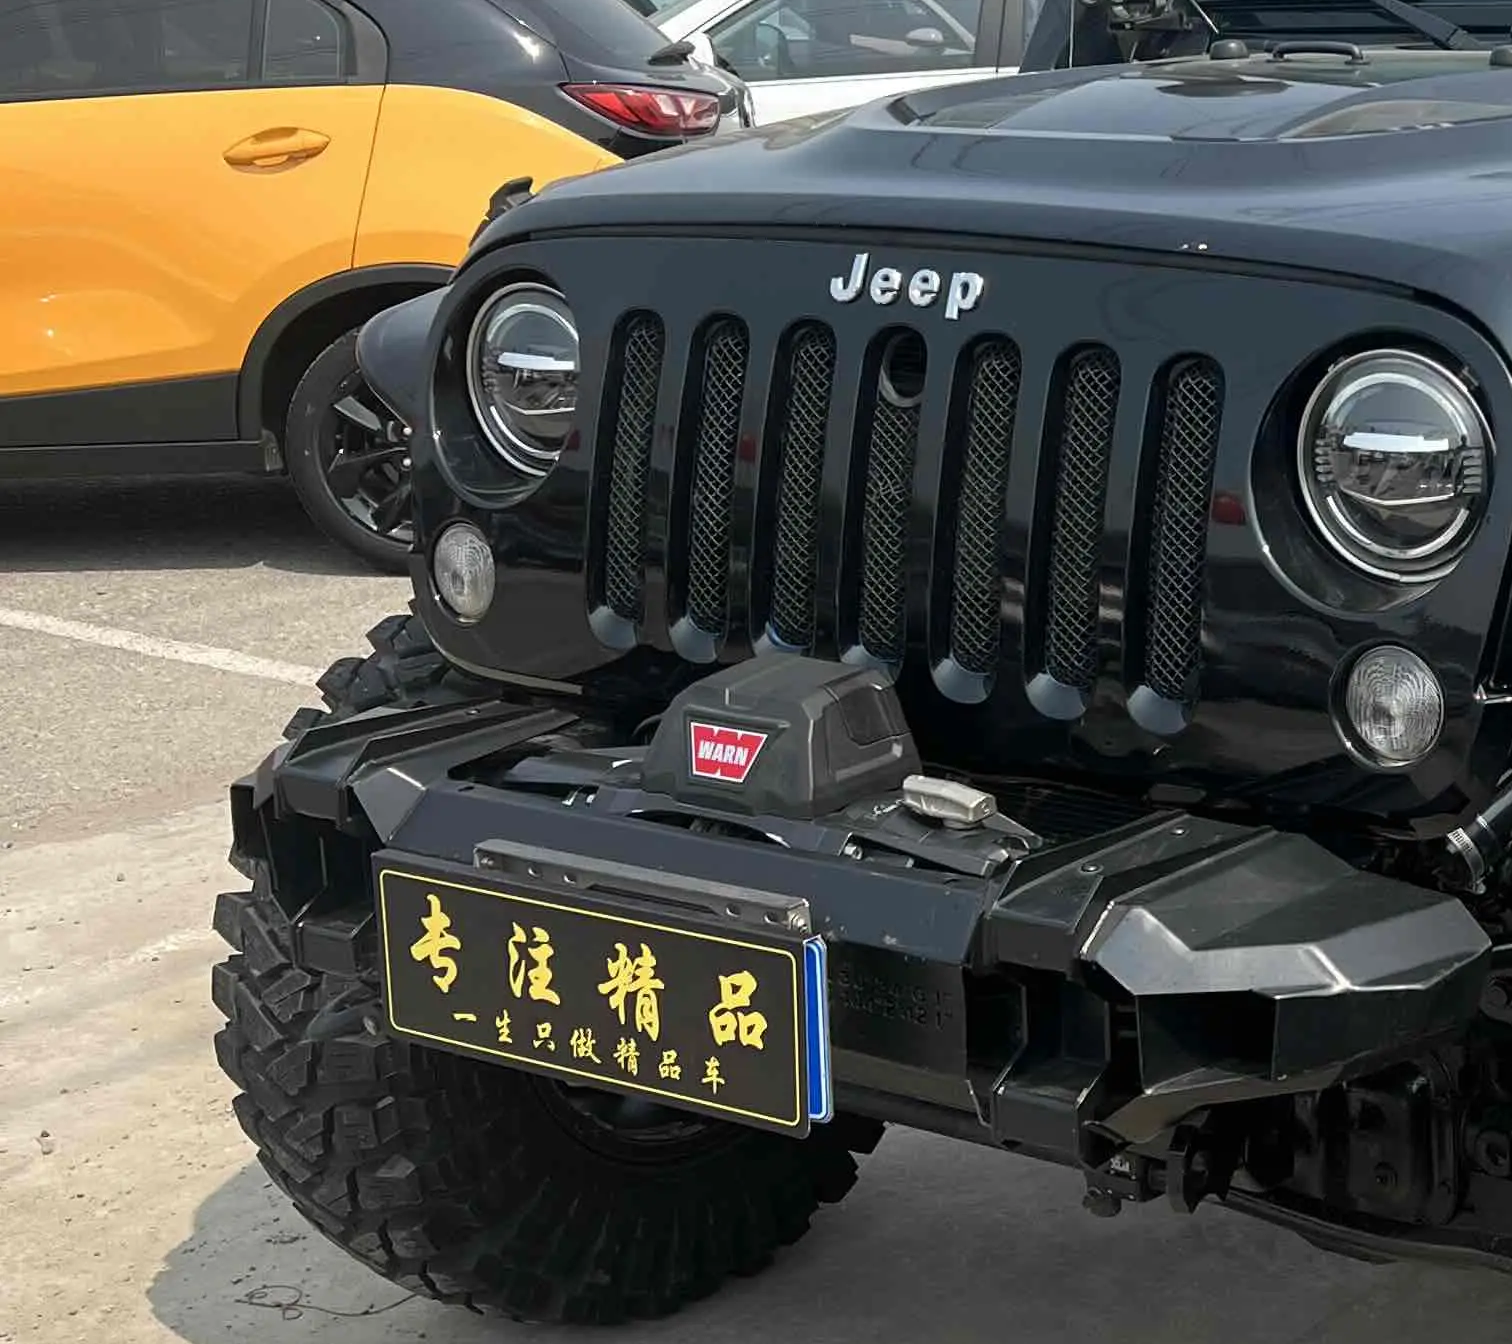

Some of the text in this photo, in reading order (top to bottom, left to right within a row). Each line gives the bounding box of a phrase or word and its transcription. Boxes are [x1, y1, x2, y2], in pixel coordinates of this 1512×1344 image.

[830, 252, 986, 321] Jeep
[695, 739, 753, 768] WARN
[410, 892, 769, 1053] 专注精品
[451, 1007, 727, 1096] 一生只做精品车
